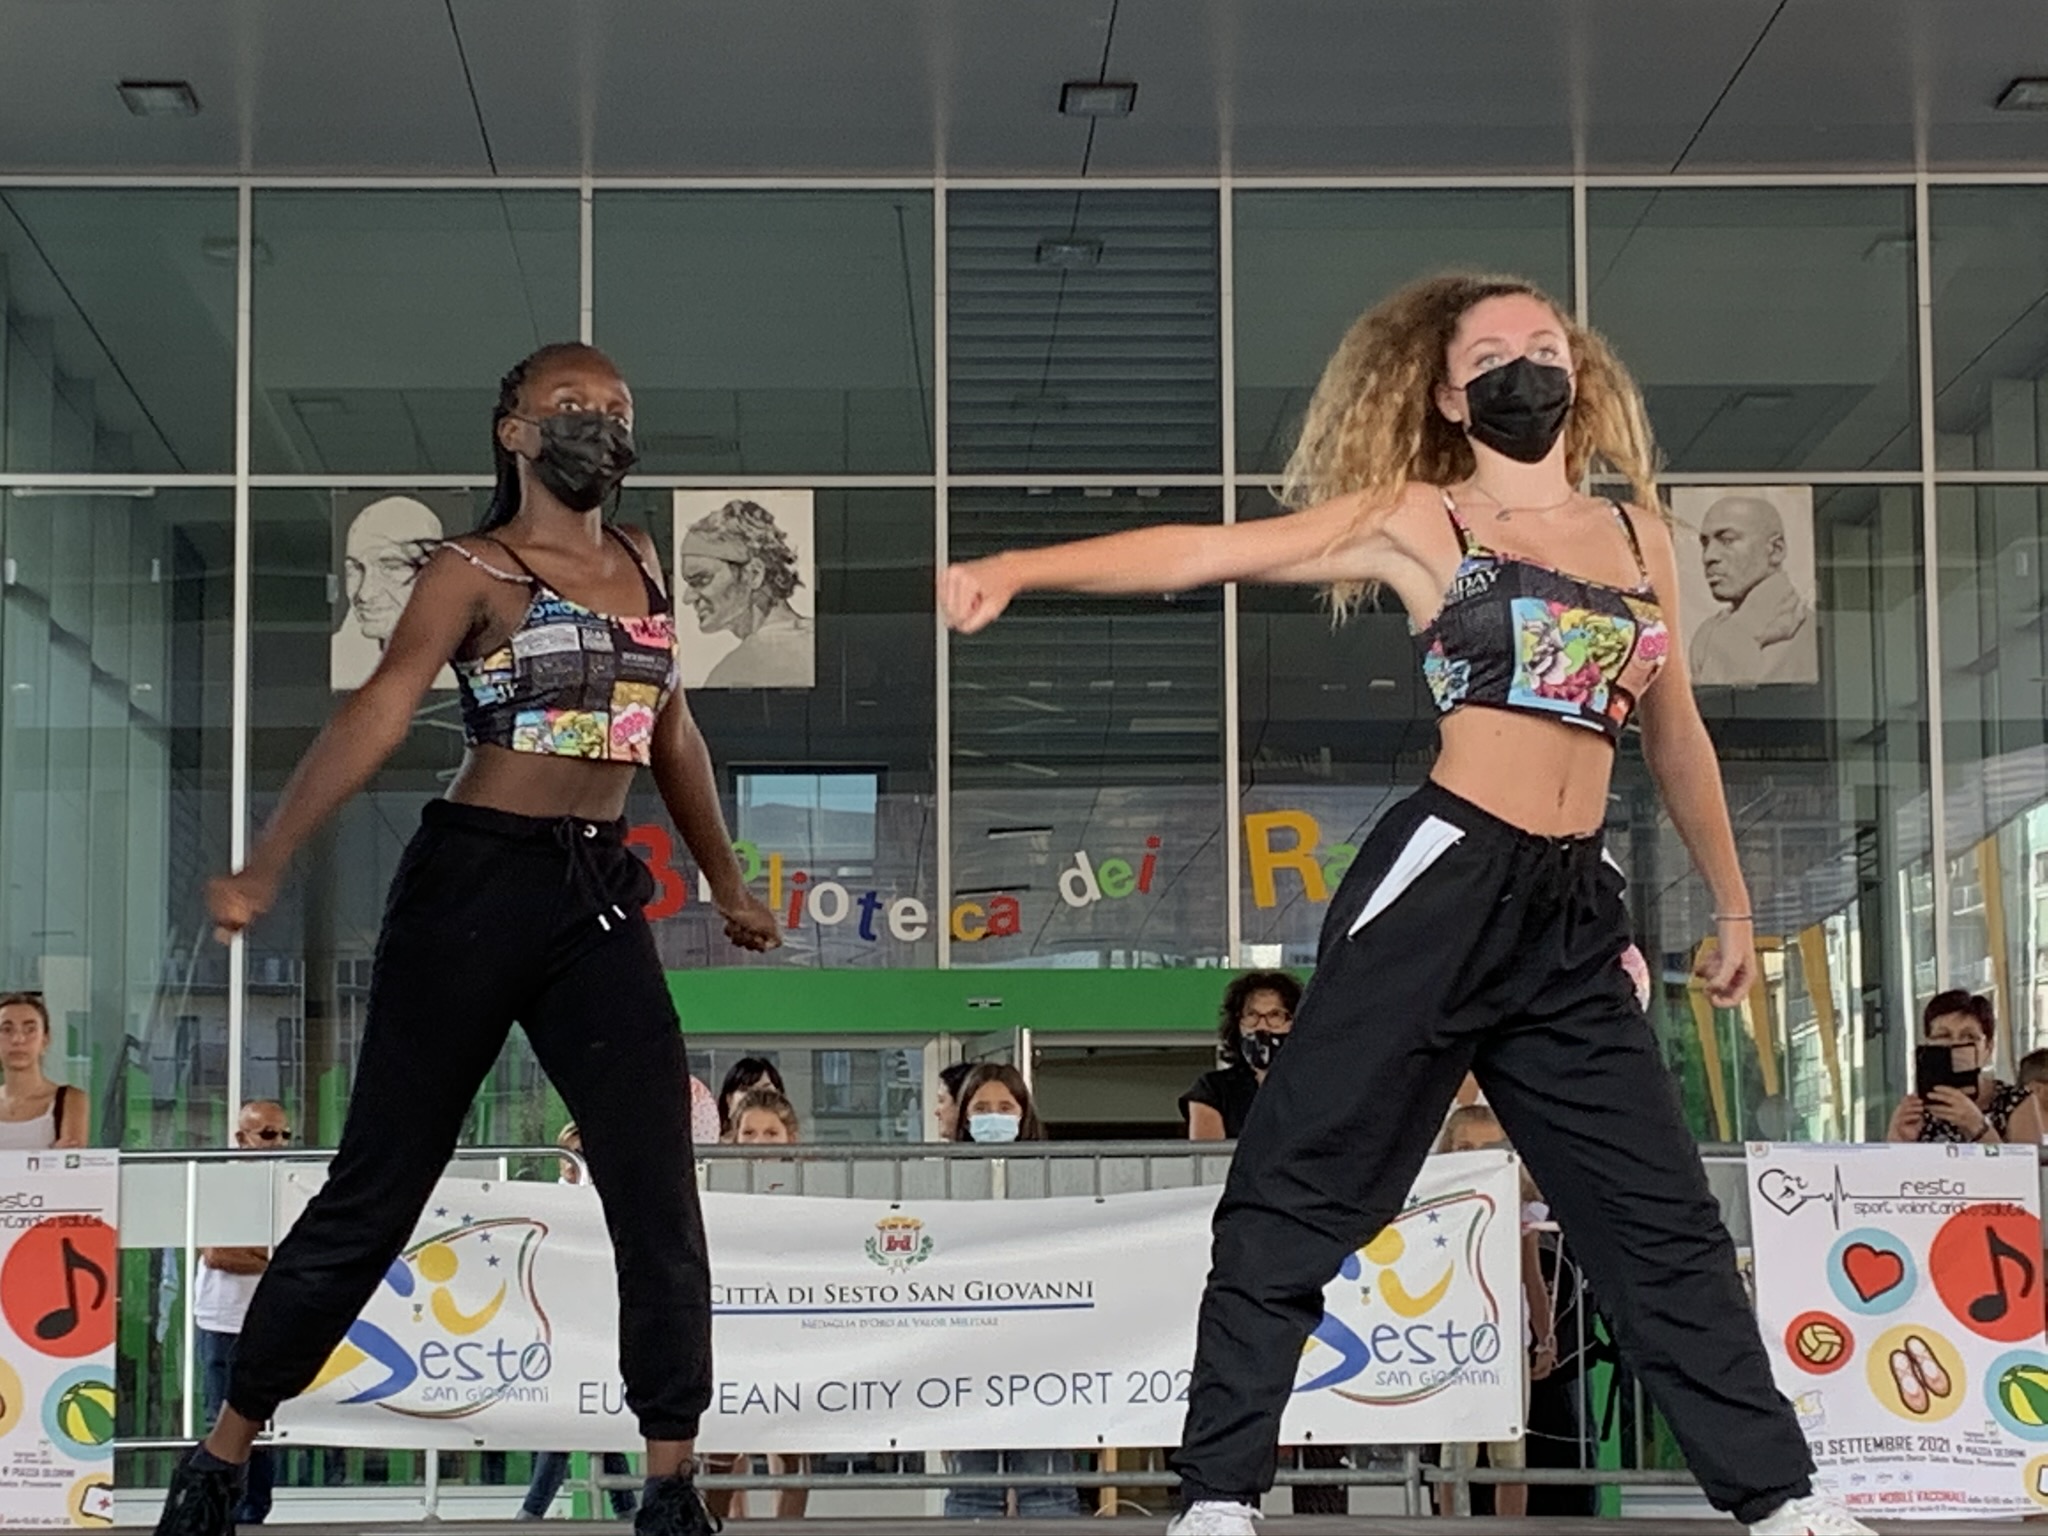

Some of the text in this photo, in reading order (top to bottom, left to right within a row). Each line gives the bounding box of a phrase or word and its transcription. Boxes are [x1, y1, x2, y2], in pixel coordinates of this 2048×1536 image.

[1058, 836, 1161, 908] dei
[824, 1283, 898, 1304] SESTO
[907, 1282, 955, 1302] SAN
[964, 1280, 1094, 1302] GIOVANNI
[578, 1369, 1193, 1415] EUEAN CITY OF SPORT 202
[1828, 1435, 1914, 1456] SETTEMBRE
[1917, 1435, 1950, 1453] 2021
